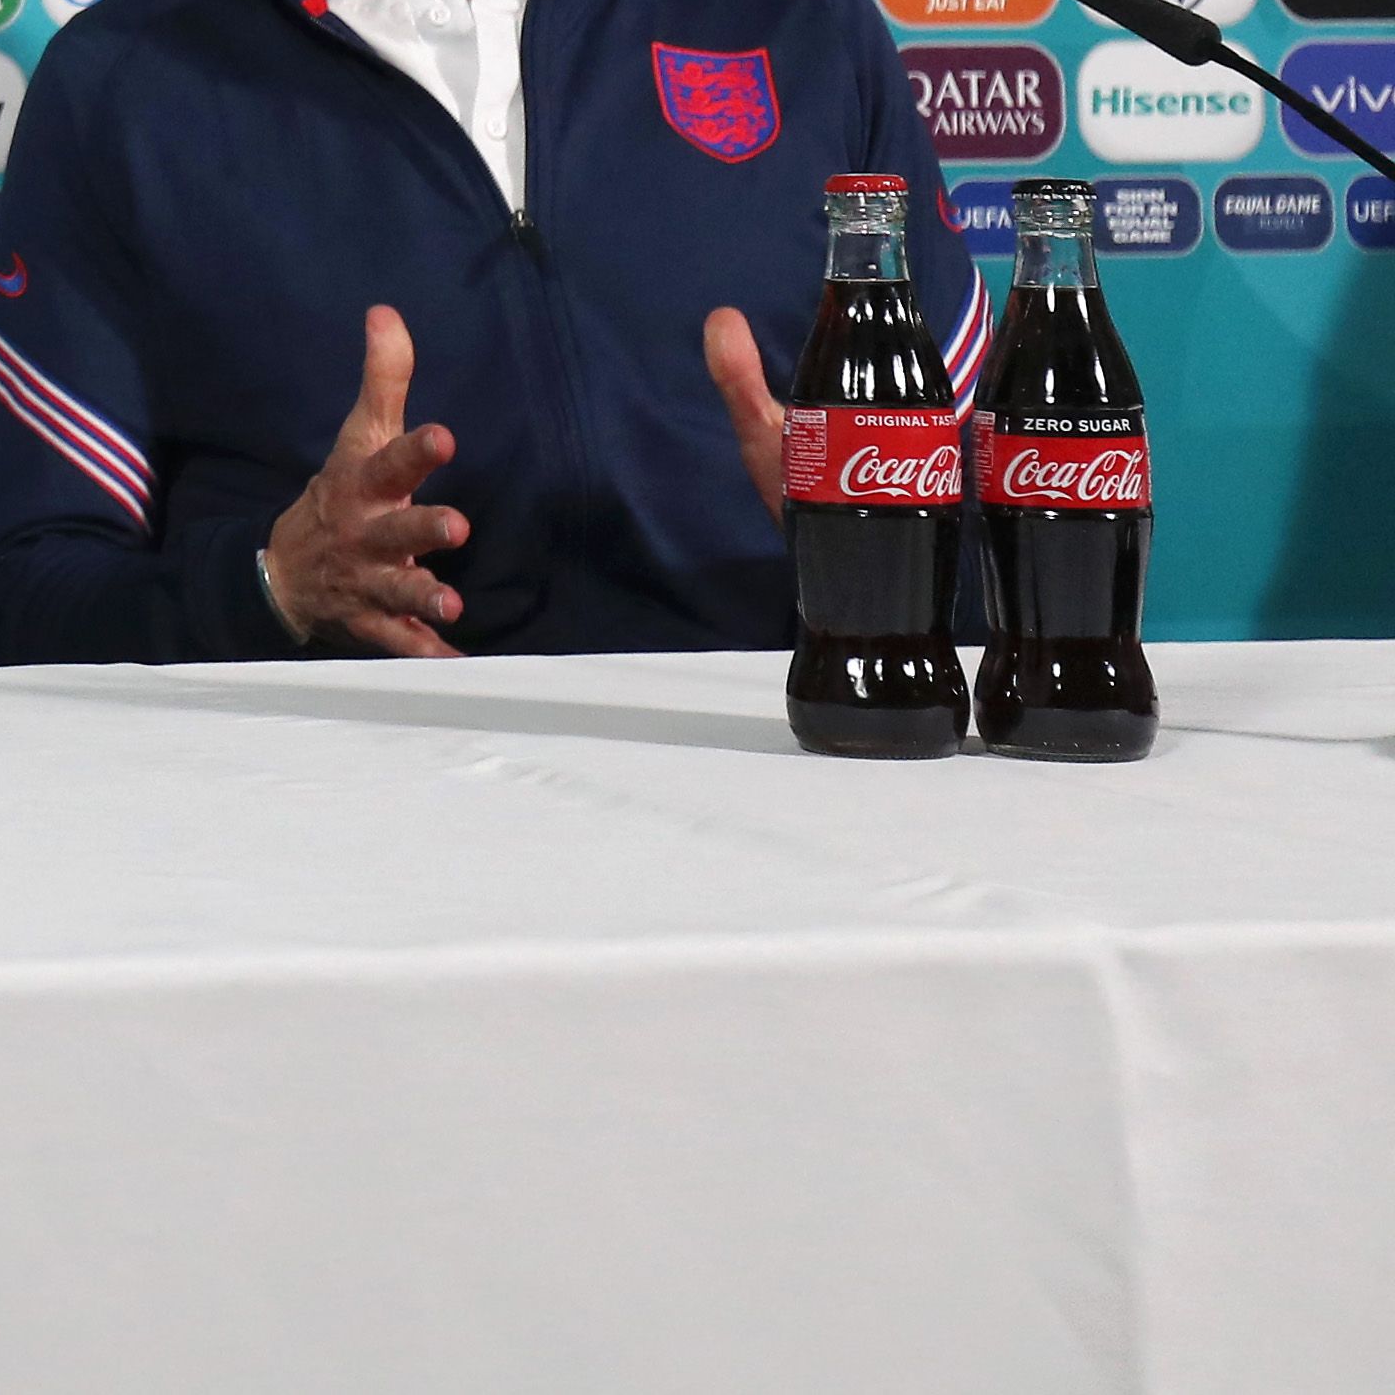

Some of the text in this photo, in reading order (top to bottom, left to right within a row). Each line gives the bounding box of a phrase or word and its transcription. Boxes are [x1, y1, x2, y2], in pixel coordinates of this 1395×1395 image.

[1092, 87, 1251, 115] Hisense
[934, 110, 1045, 135] AIRWAYS
[855, 415, 928, 426] ORIGINAL
[1023, 419, 1131, 432] ZERO SUGAR
[1003, 449, 1143, 501] Coca-Cola
